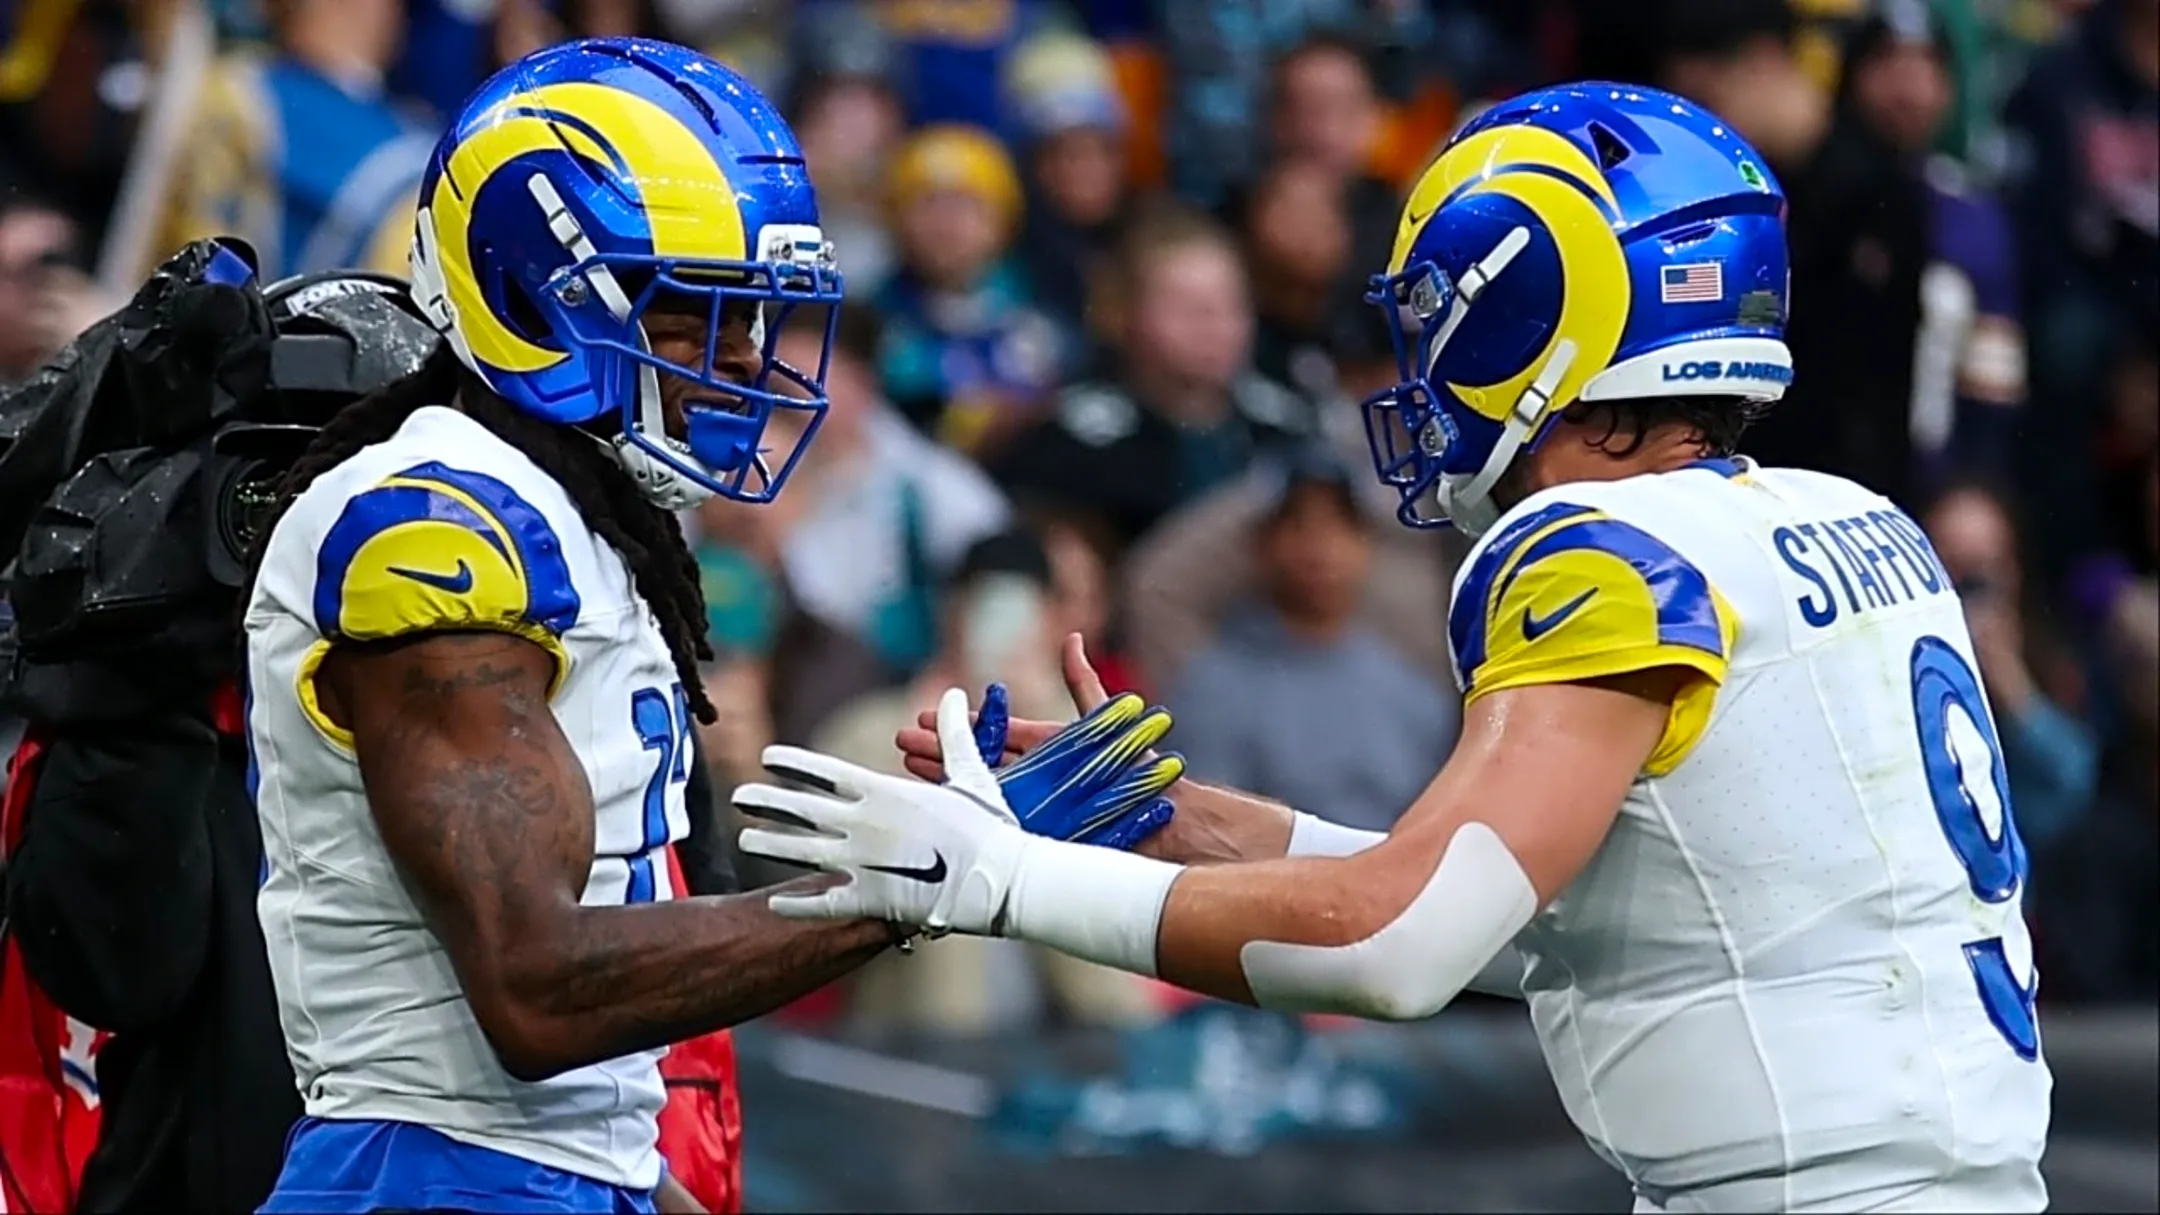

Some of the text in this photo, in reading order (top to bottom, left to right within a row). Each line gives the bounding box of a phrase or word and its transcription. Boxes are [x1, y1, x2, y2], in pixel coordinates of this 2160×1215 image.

[1663, 361, 1722, 382] LOS
[1773, 508, 1950, 628] STAFFOR
[1910, 635, 2038, 1063] 9
